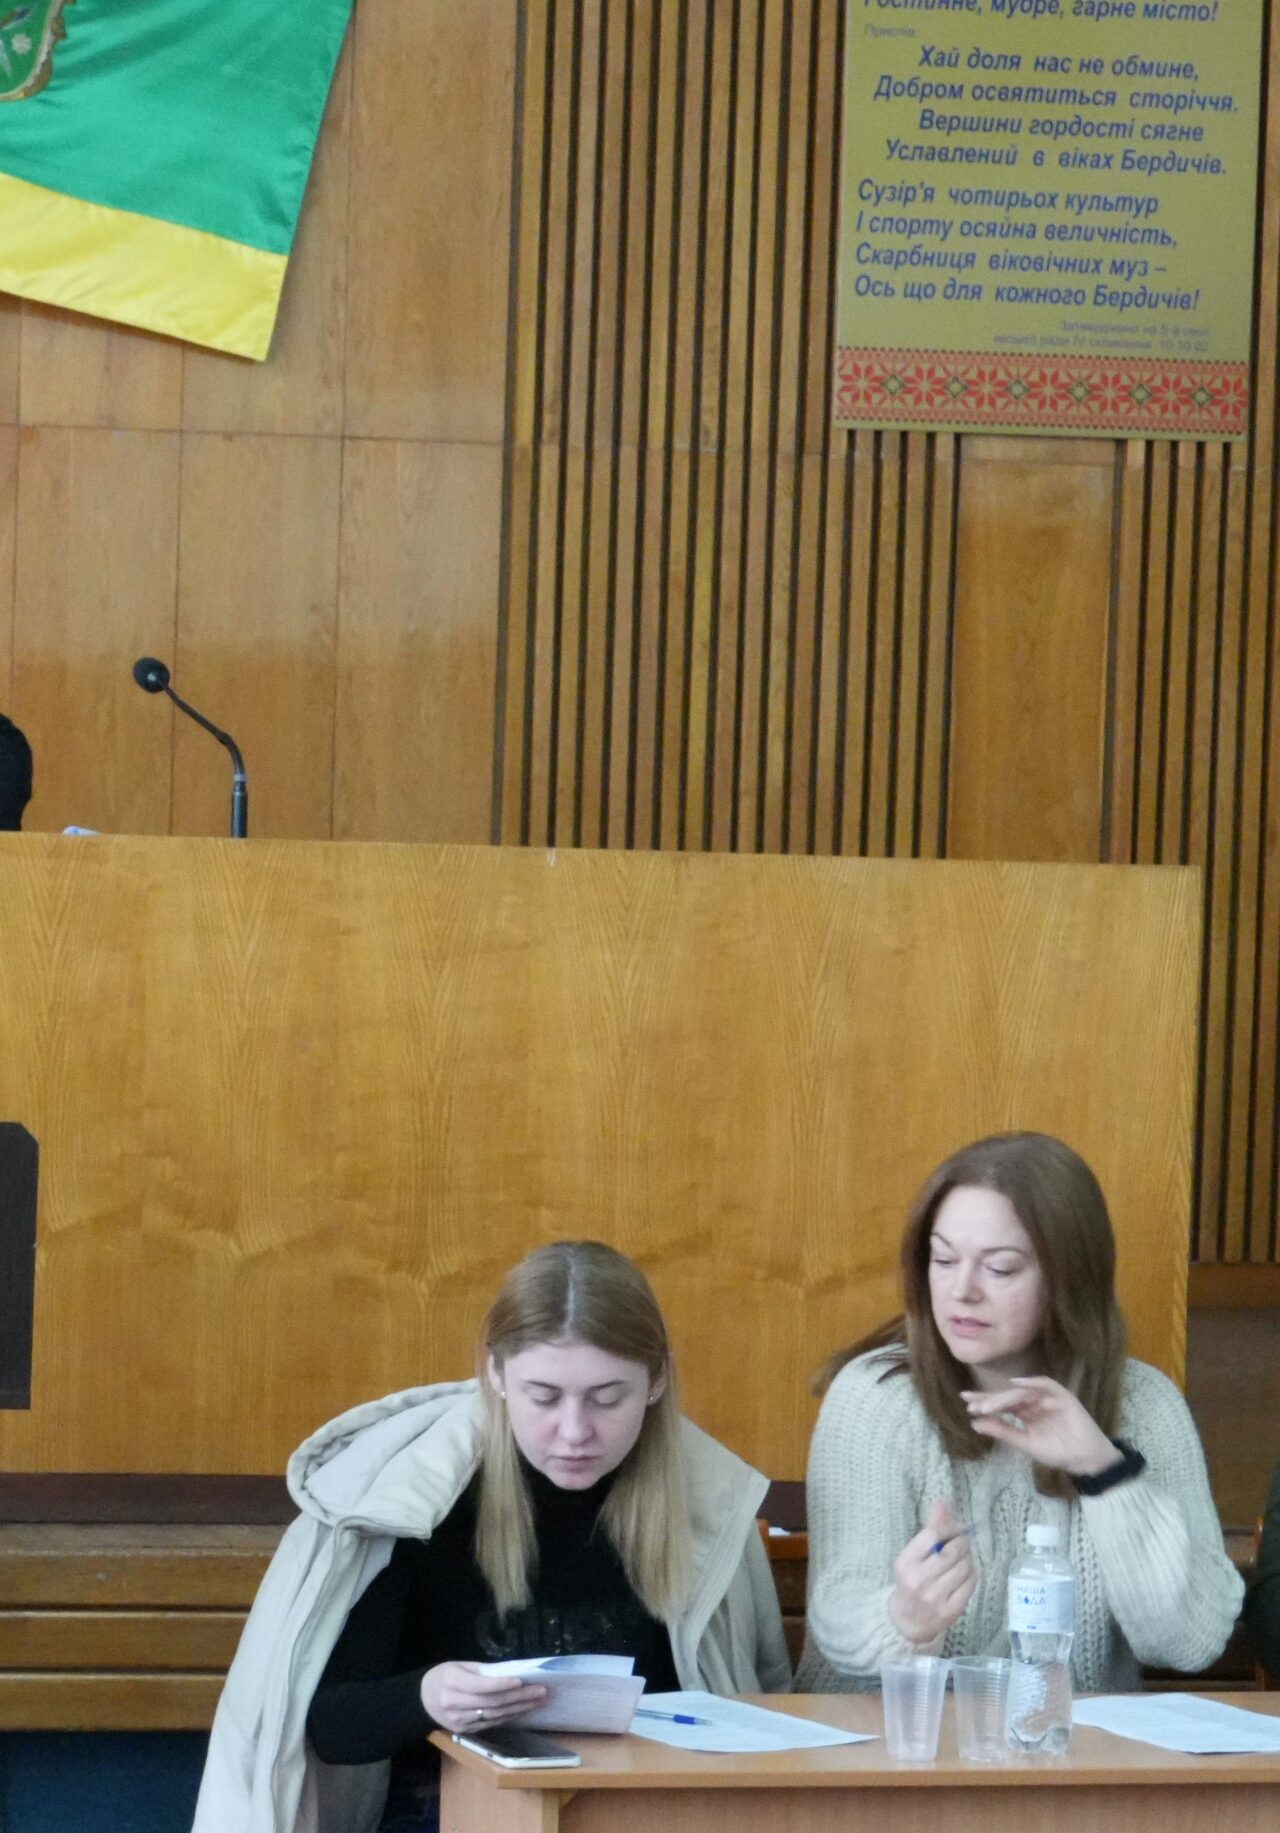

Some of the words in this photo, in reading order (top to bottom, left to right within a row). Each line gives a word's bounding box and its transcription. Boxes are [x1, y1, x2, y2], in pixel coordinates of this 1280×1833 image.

[1072, 1, 1136, 22] гарне
[1142, 0, 1218, 22] місто!
[919, 45, 960, 68] Хай
[967, 47, 1021, 71] доля
[1034, 56, 1072, 73] нас
[1079, 58, 1104, 76] не
[1111, 54, 1199, 81] обмине,
[873, 75, 964, 103] Добром
[972, 84, 1117, 106] освятиться
[1129, 89, 1237, 114] сторіччя.
[919, 108, 1023, 136] Вершини
[1029, 115, 1135, 141] гордості
[1141, 123, 1204, 142] сягне
[886, 138, 1019, 166] Уславлений
[1033, 150, 1045, 167] в
[1059, 147, 1115, 169] віках
[1120, 149, 1227, 176] Бердичів.
[858, 178, 935, 208] Сузір'я
[948, 187, 1058, 212] чотирьох
[1064, 193, 1159, 219] культур
[869, 215, 953, 242] спорту
[959, 217, 1037, 240] осяйна
[1044, 221, 1177, 248] величність,
[855, 242, 976, 274] Скарбниця
[988, 249, 1103, 275] віковічних
[1110, 259, 1149, 282] муз
[854, 274, 896, 298] Ось
[903, 281, 936, 302] що
[943, 277, 983, 301] для
[994, 286, 1086, 306] кожного
[1092, 284, 1201, 313] Бердичів!
